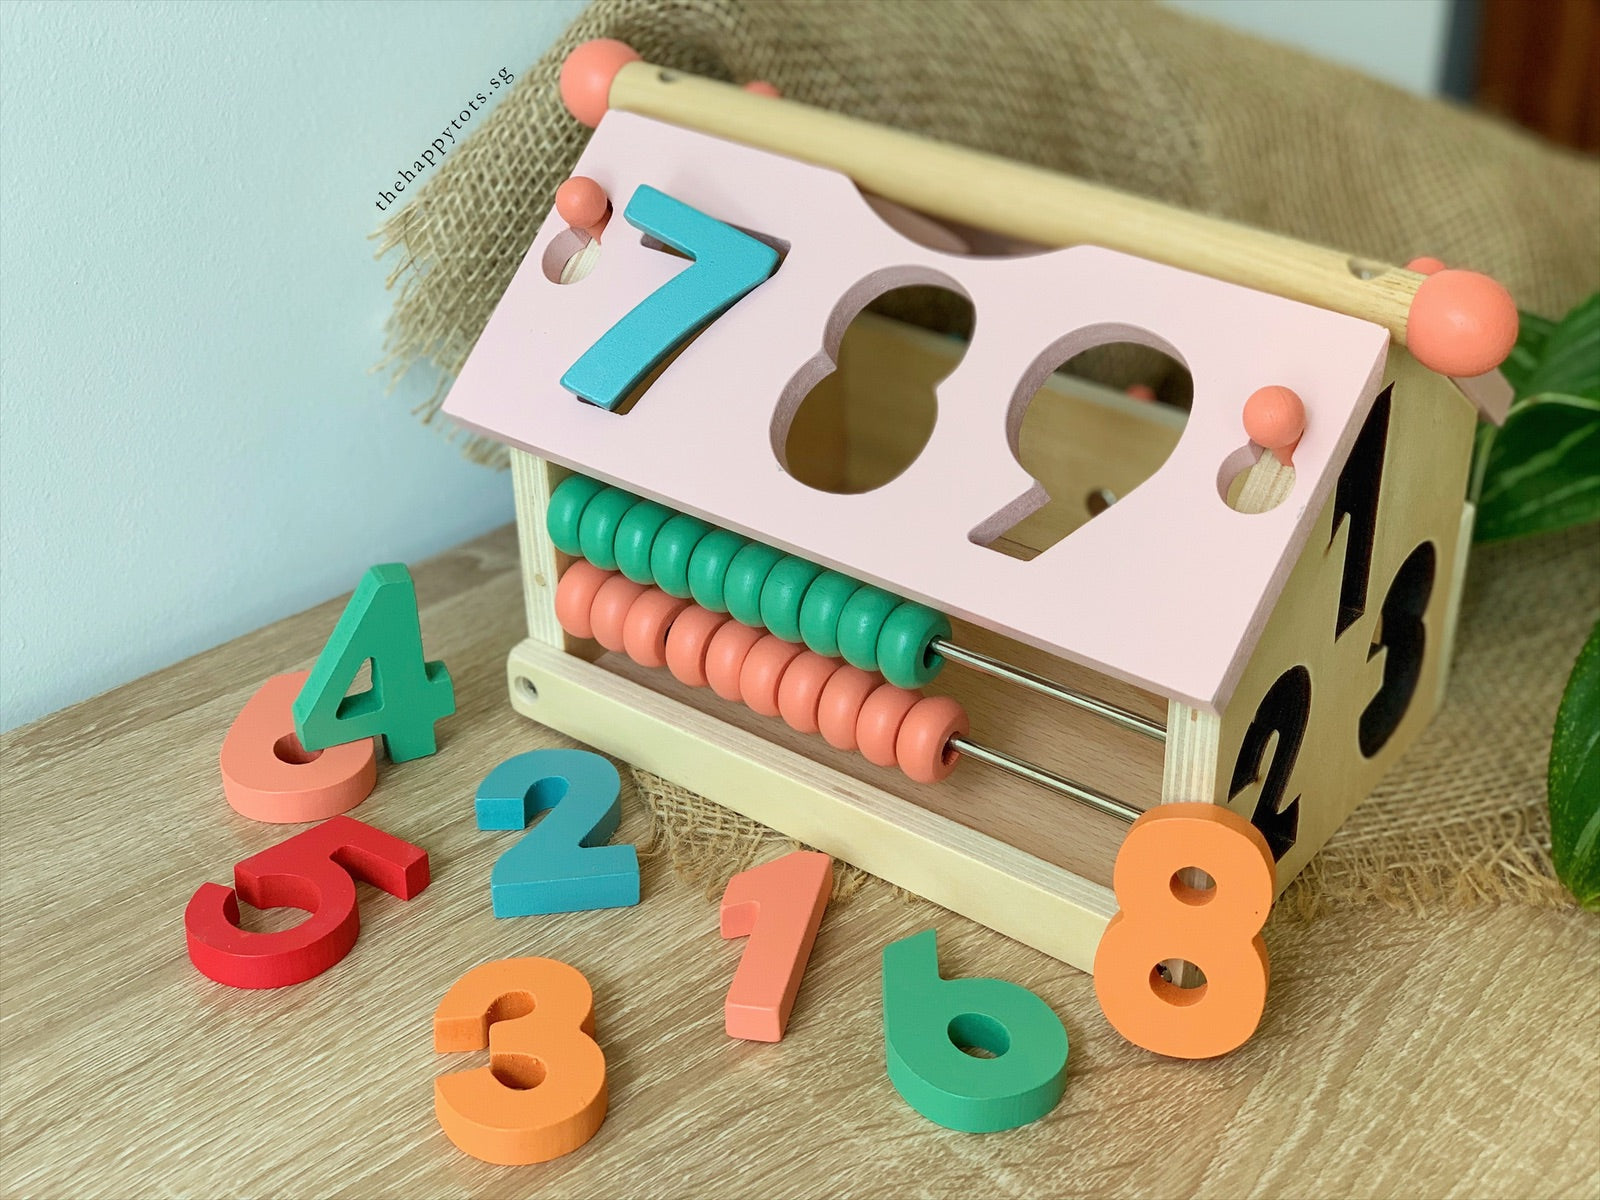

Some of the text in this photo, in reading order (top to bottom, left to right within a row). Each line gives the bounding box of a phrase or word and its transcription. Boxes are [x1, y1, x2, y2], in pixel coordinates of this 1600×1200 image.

[560, 184, 1194, 561] 7 8 9
[292, 562, 455, 763] 4
[185, 815, 432, 989] 5
[475, 748, 641, 918] 2
[1094, 803, 1276, 1060] 8
[720, 850, 834, 1042] 1
[433, 956, 608, 1165] 3
